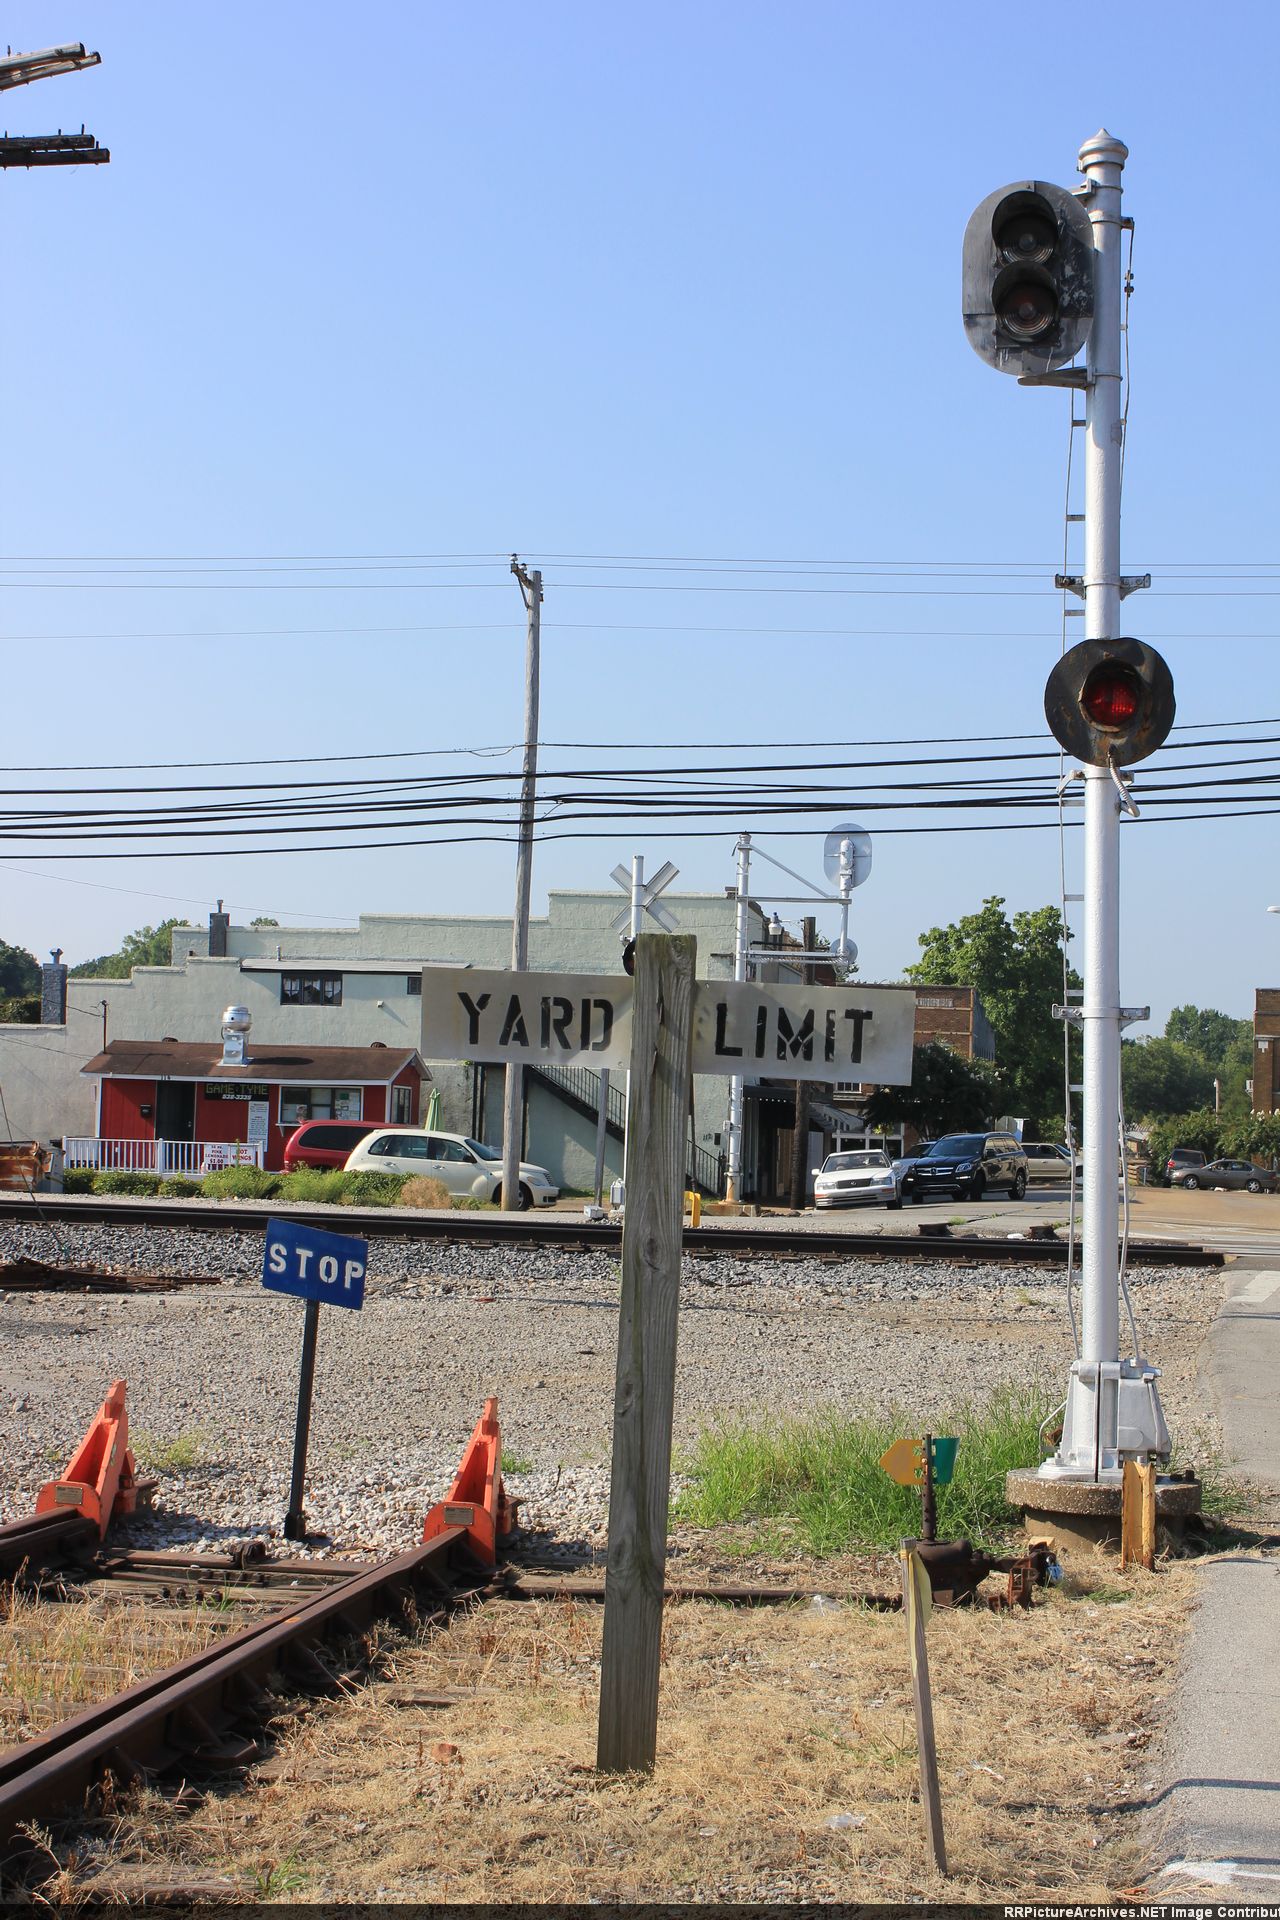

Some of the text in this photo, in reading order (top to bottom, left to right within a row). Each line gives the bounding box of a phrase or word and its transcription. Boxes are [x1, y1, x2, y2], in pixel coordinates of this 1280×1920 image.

[457, 991, 873, 1065] YARD LIMIT
[205, 1083, 268, 1095] GAME TYME
[269, 1243, 364, 1289] STOP
